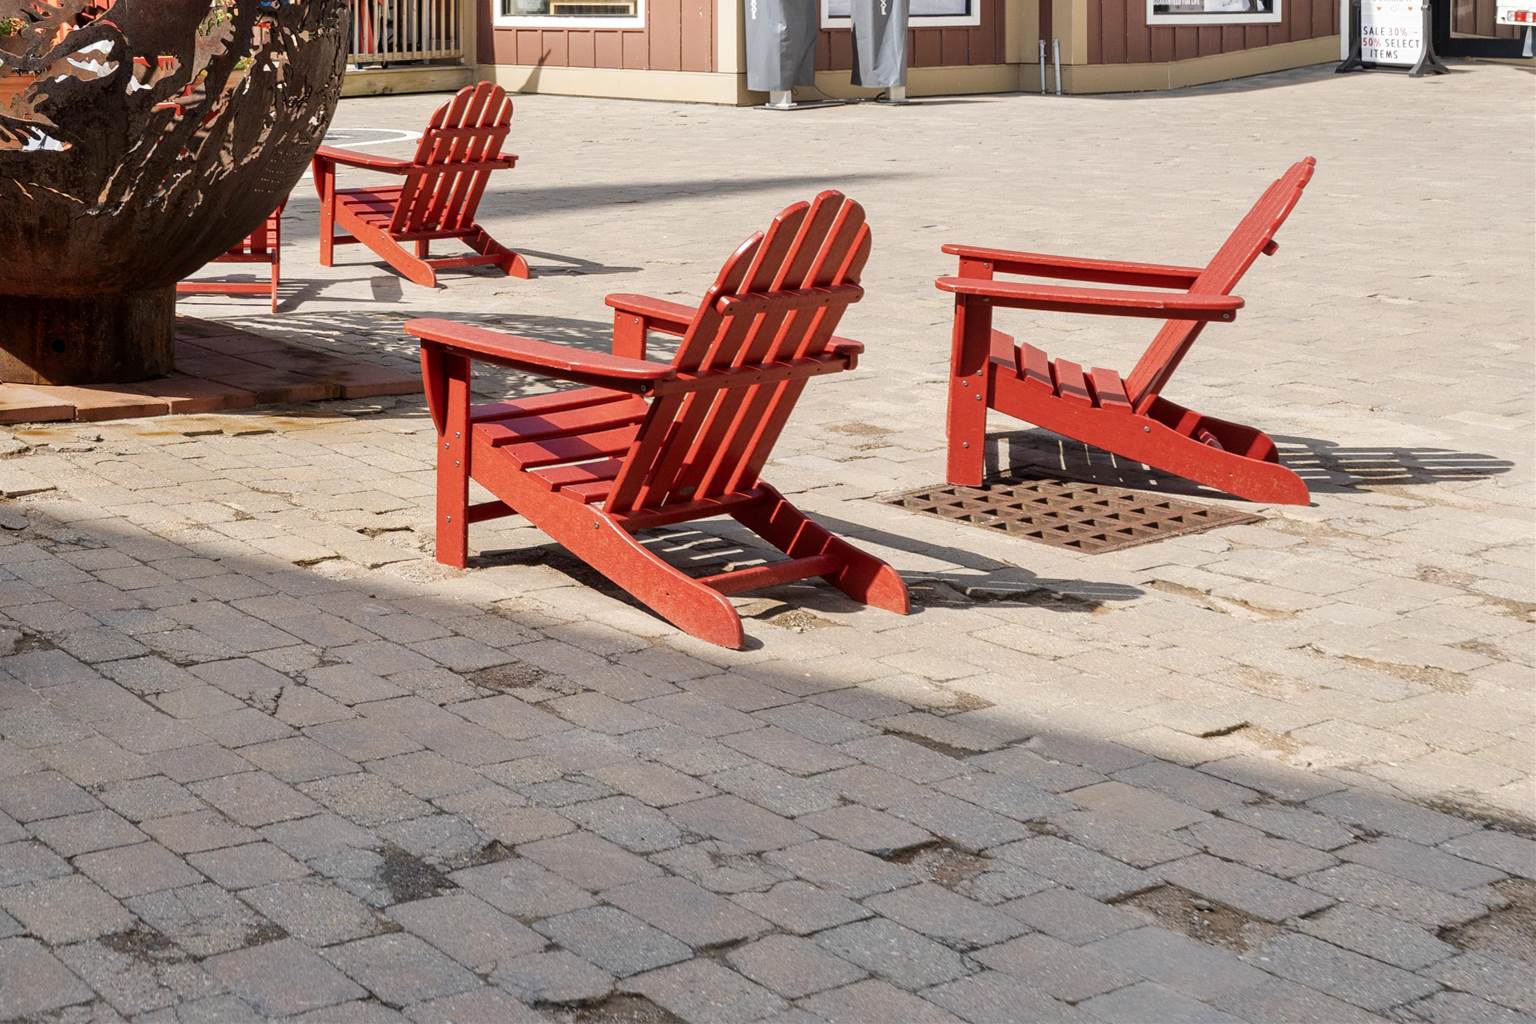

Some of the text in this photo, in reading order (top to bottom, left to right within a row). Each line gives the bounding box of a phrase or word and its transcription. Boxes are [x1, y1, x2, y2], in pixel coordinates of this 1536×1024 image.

[1363, 26, 1385, 36] SALE
[1388, 27, 1408, 37] 30%
[1362, 37, 1420, 48] 50% SELECT
[1370, 49, 1398, 59] ITEMS
